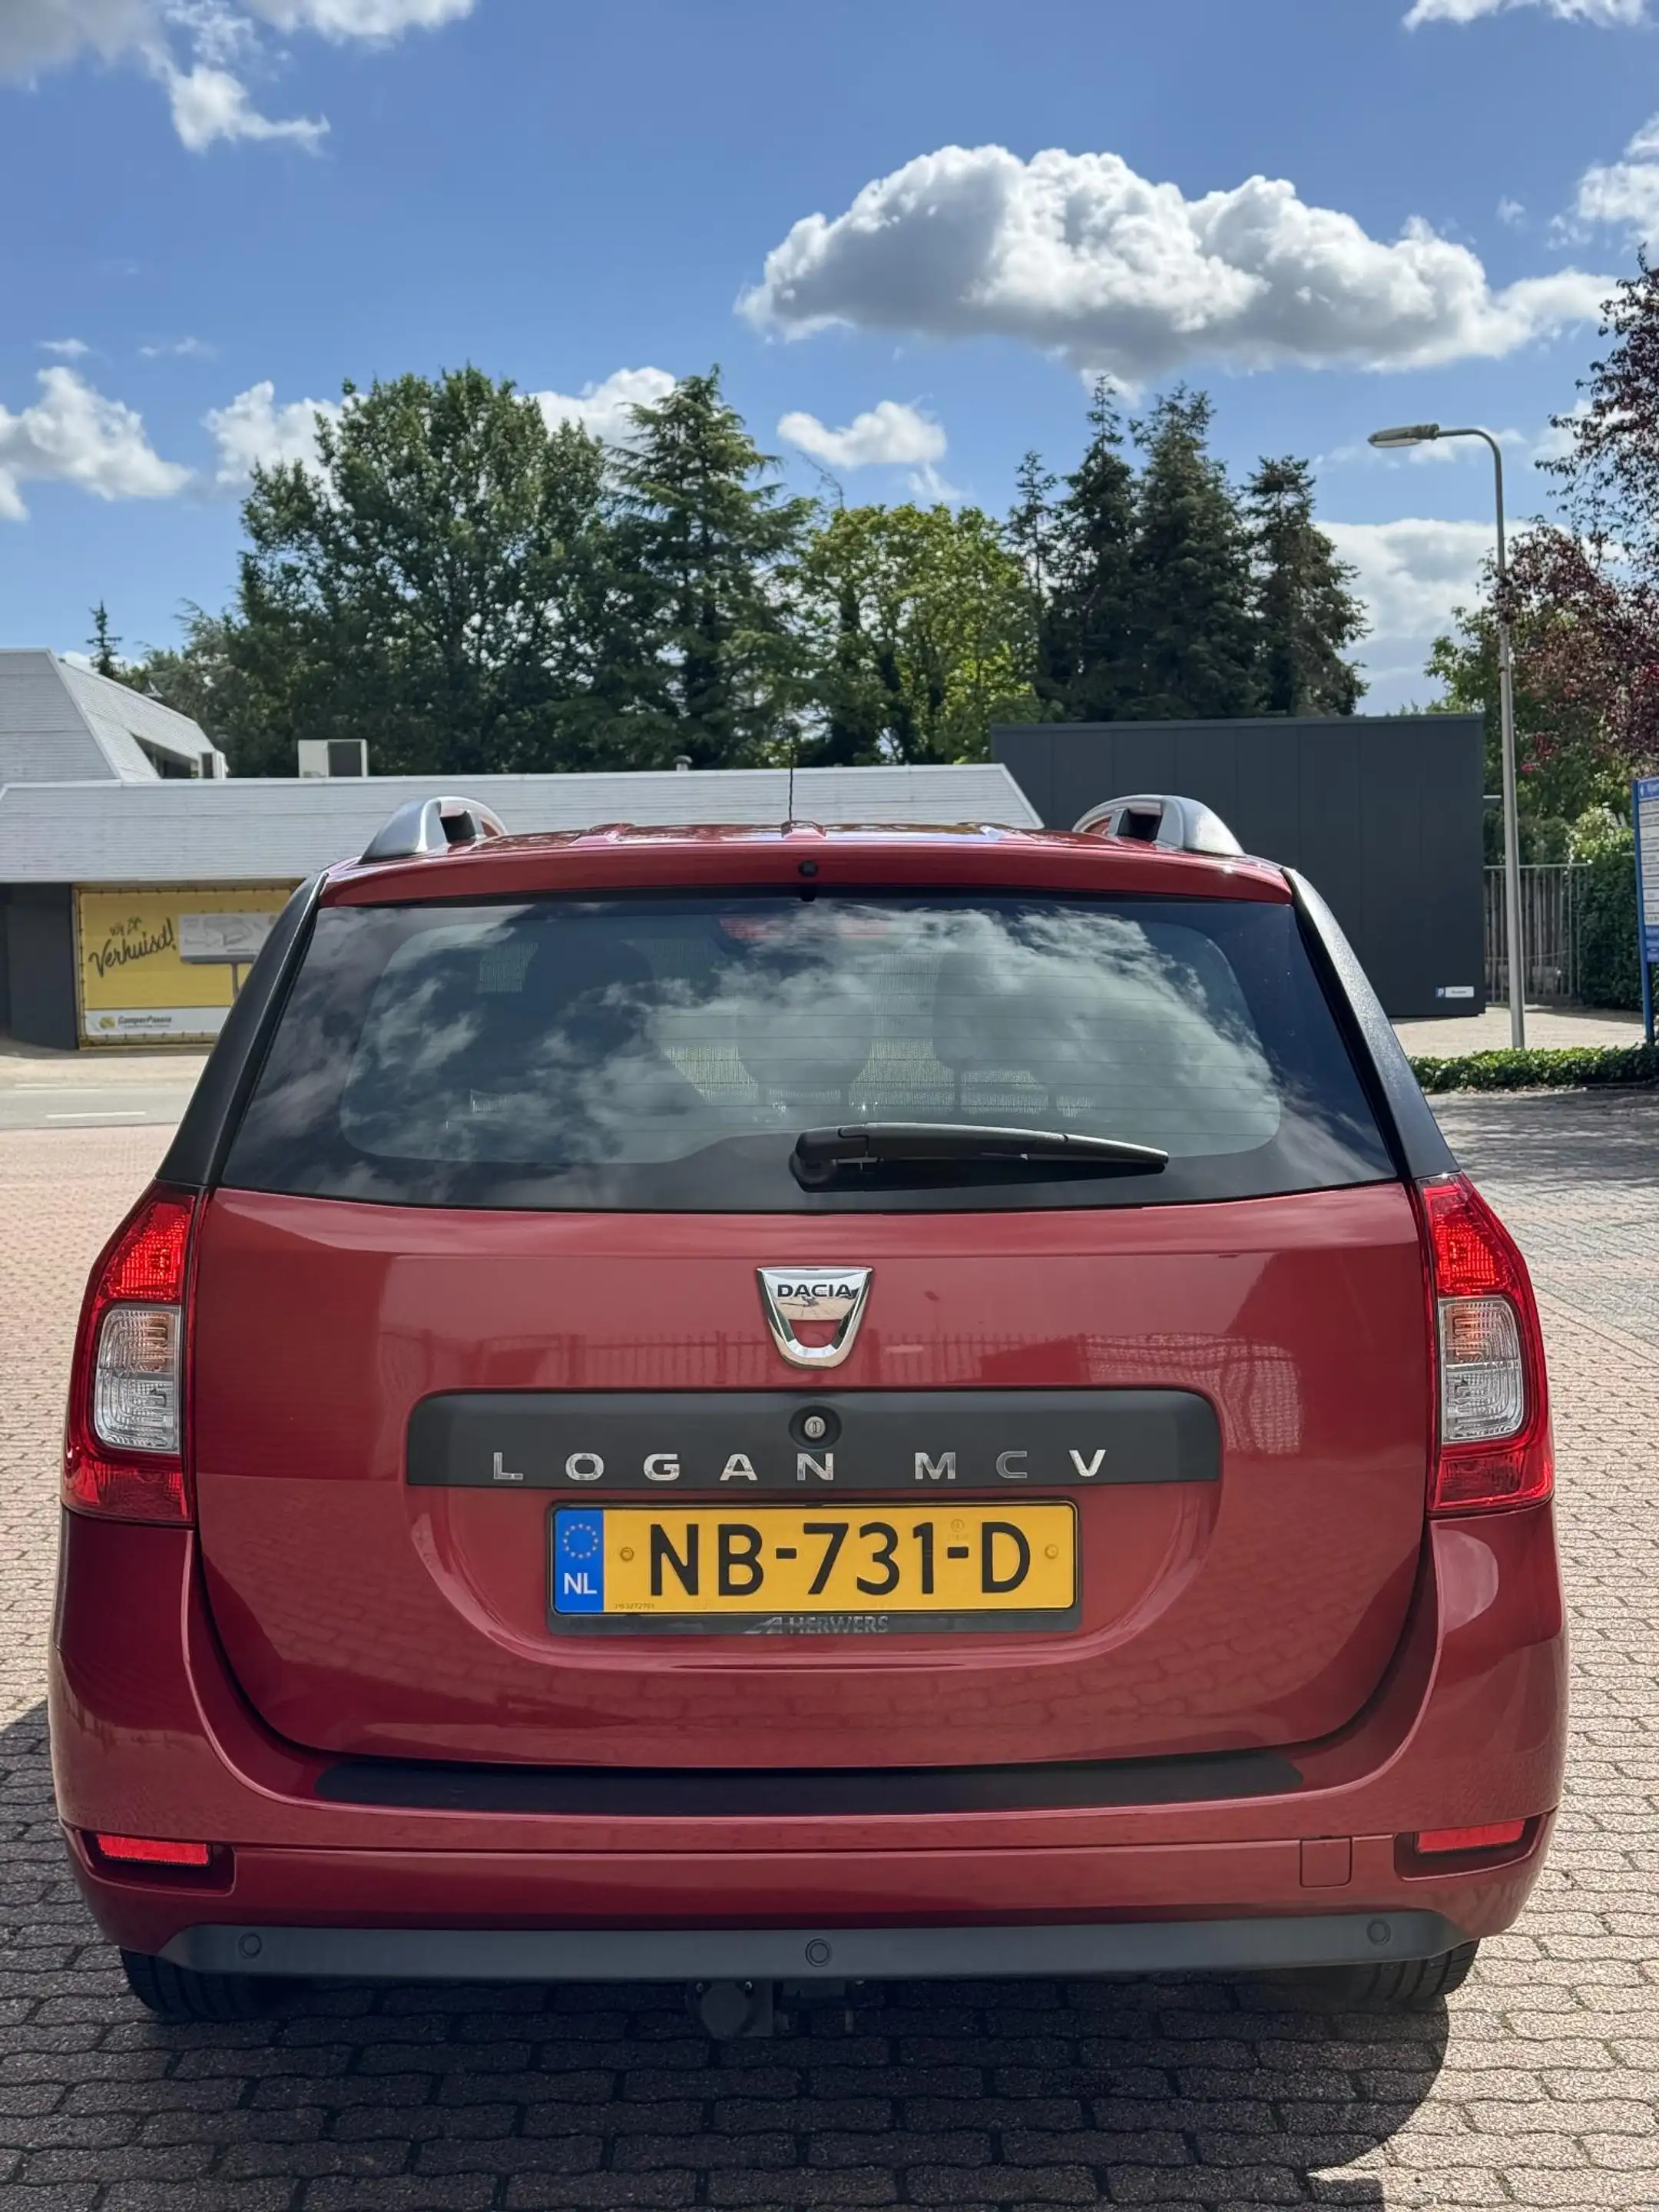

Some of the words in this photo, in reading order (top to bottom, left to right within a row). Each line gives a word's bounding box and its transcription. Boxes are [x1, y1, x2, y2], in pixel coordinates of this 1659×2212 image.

[88, 916, 177, 977] Verhuisd!
[777, 1283, 853, 1298] DACIA
[492, 1452, 835, 1482] LOGAN
[914, 1449, 1108, 1480] MCV
[649, 1521, 1031, 1597] NB-731-D
[564, 1572, 598, 1595] NL
[789, 1615, 889, 1634] HERWERS
